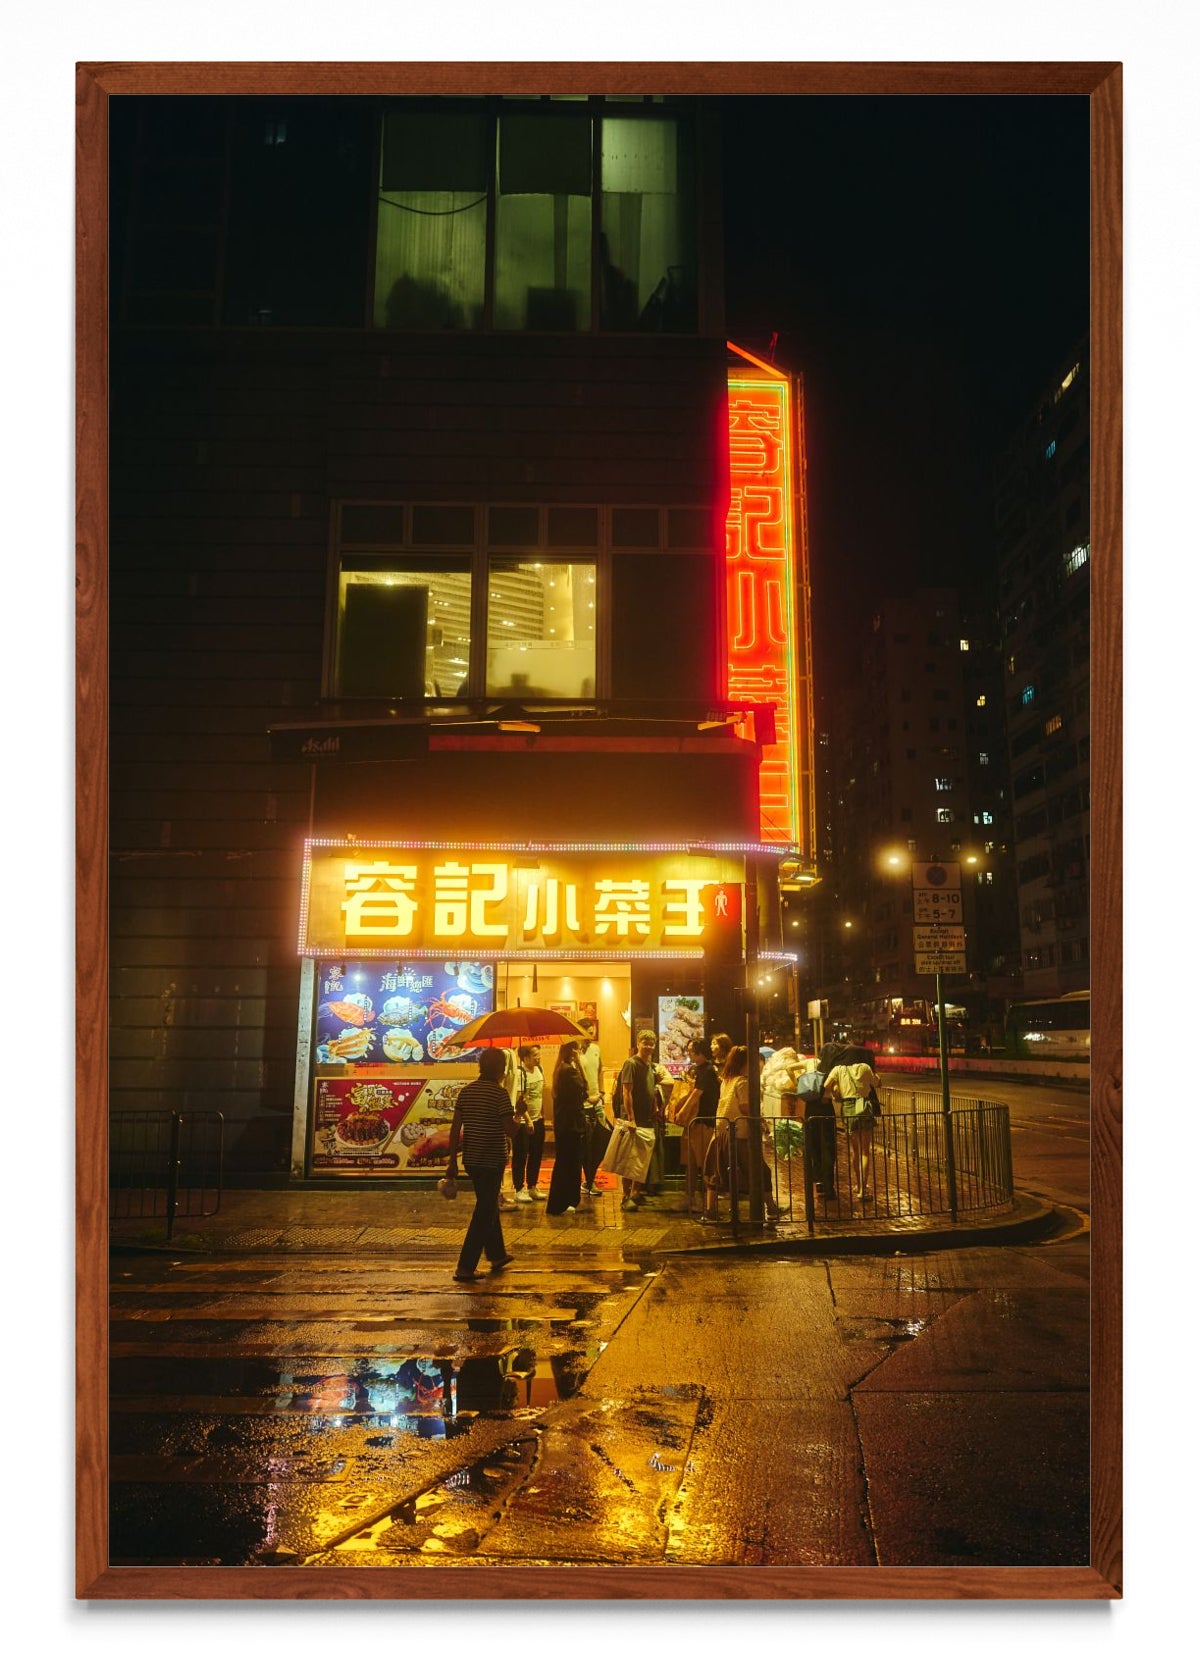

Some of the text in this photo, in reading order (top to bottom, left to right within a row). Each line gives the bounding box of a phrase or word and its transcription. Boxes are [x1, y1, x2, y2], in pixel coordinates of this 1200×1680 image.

[341, 861, 718, 936] 容記小菜王
[932, 893, 960, 904] 8-10
[933, 909, 956, 919] 5-7
